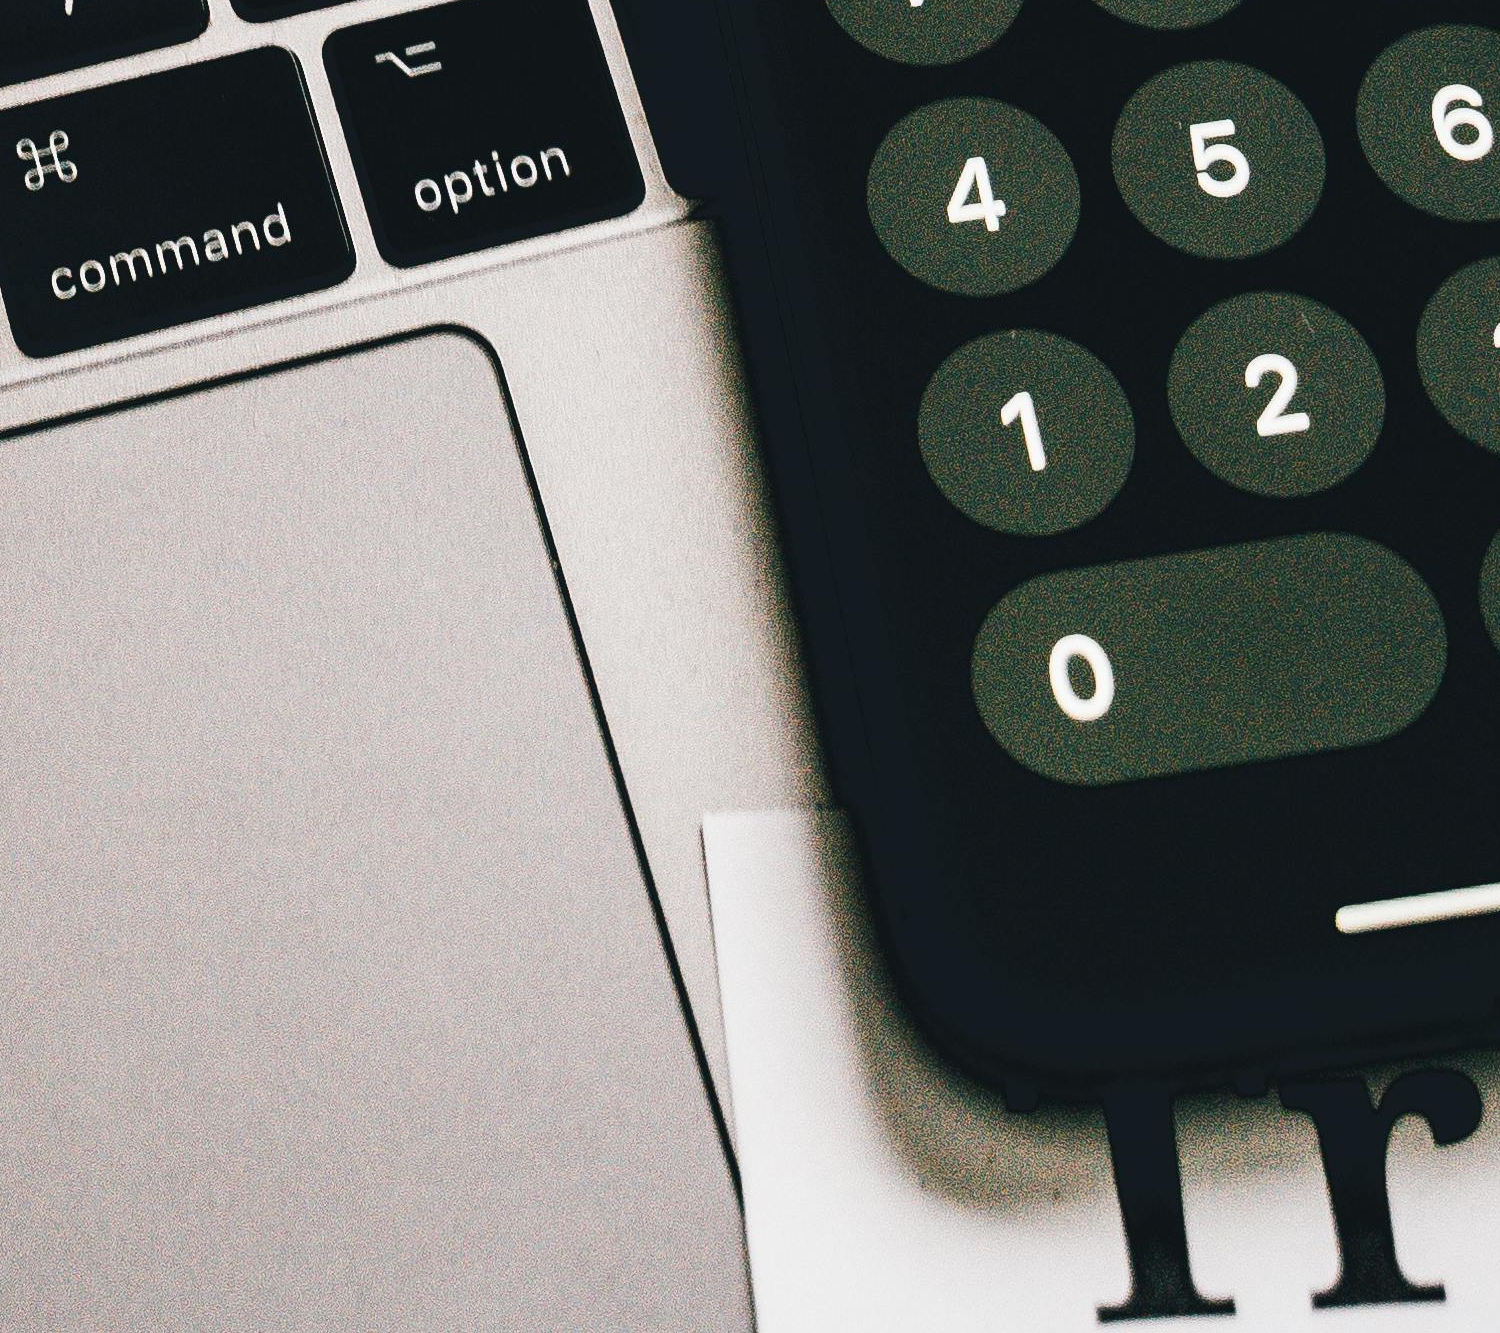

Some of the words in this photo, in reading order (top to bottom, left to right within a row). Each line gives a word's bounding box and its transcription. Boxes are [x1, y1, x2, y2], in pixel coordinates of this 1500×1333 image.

[1189, 119, 1251, 198] 5
[1431, 84, 1494, 161] 6
[414, 147, 571, 214] option
[946, 156, 1007, 232] 4
[49, 201, 294, 300] command
[1000, 391, 1047, 472] 1
[1244, 353, 1311, 437] 2
[1049, 634, 1115, 721] 0
